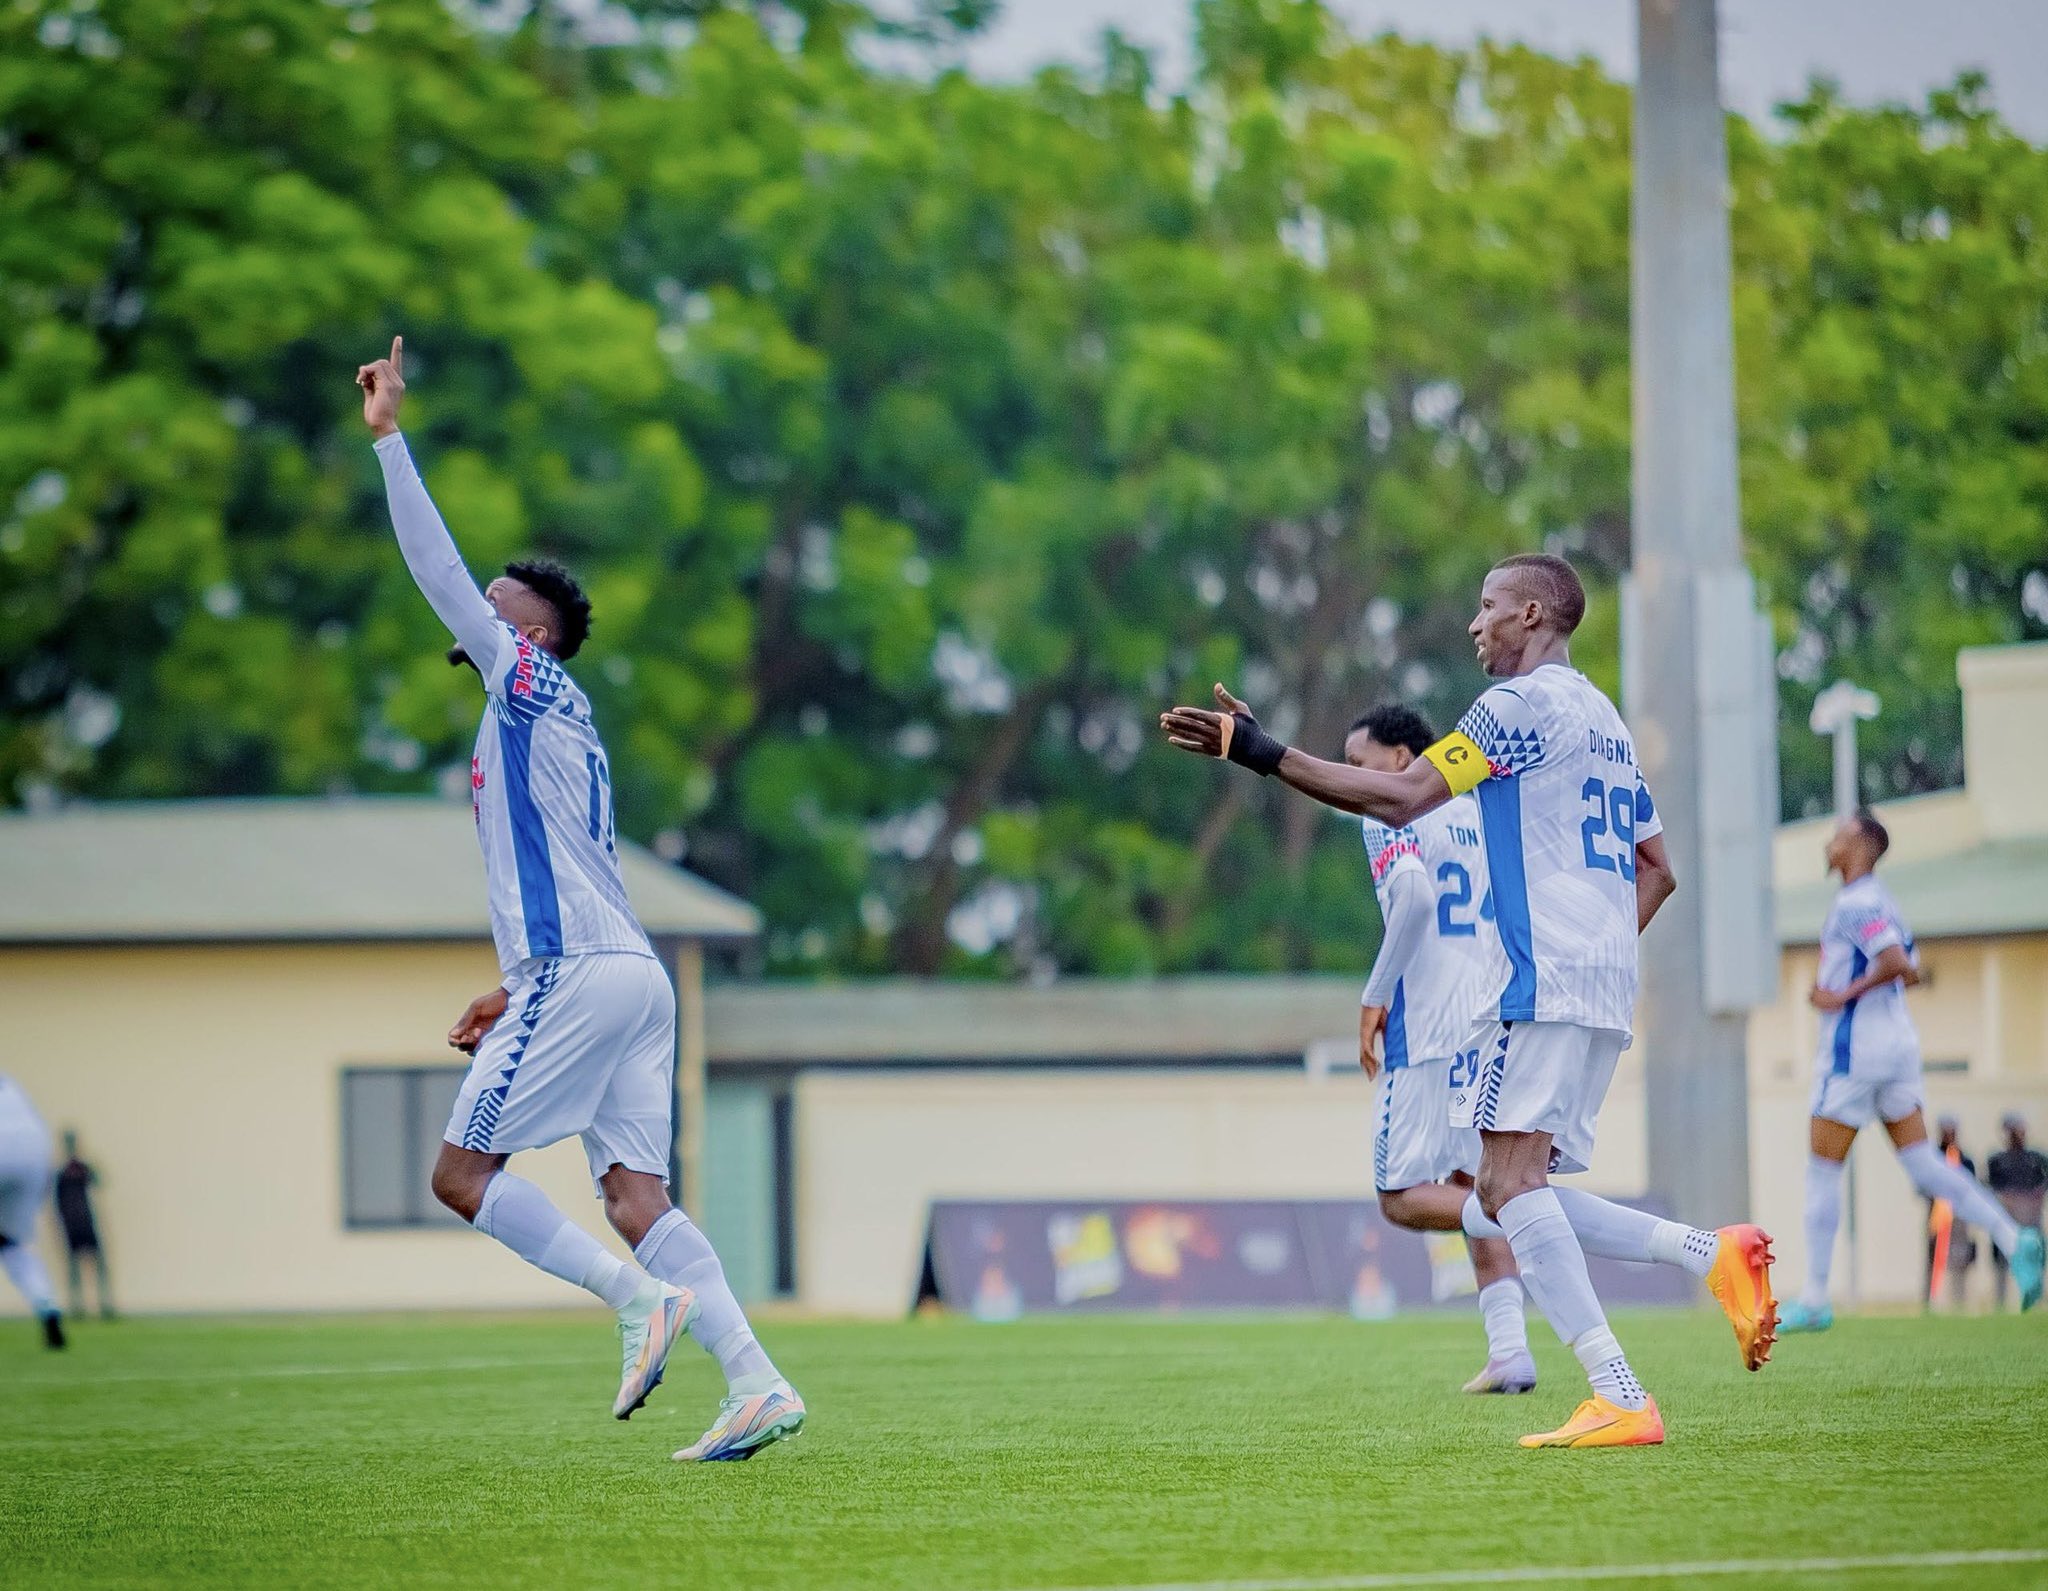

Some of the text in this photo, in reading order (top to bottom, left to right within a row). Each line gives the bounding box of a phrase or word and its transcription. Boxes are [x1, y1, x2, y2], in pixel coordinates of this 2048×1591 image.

[1444, 746, 1468, 765] C
[1589, 728, 1633, 766] DIAGNE
[1581, 776, 1635, 885] 29
[1449, 1048, 1480, 1089] 29
